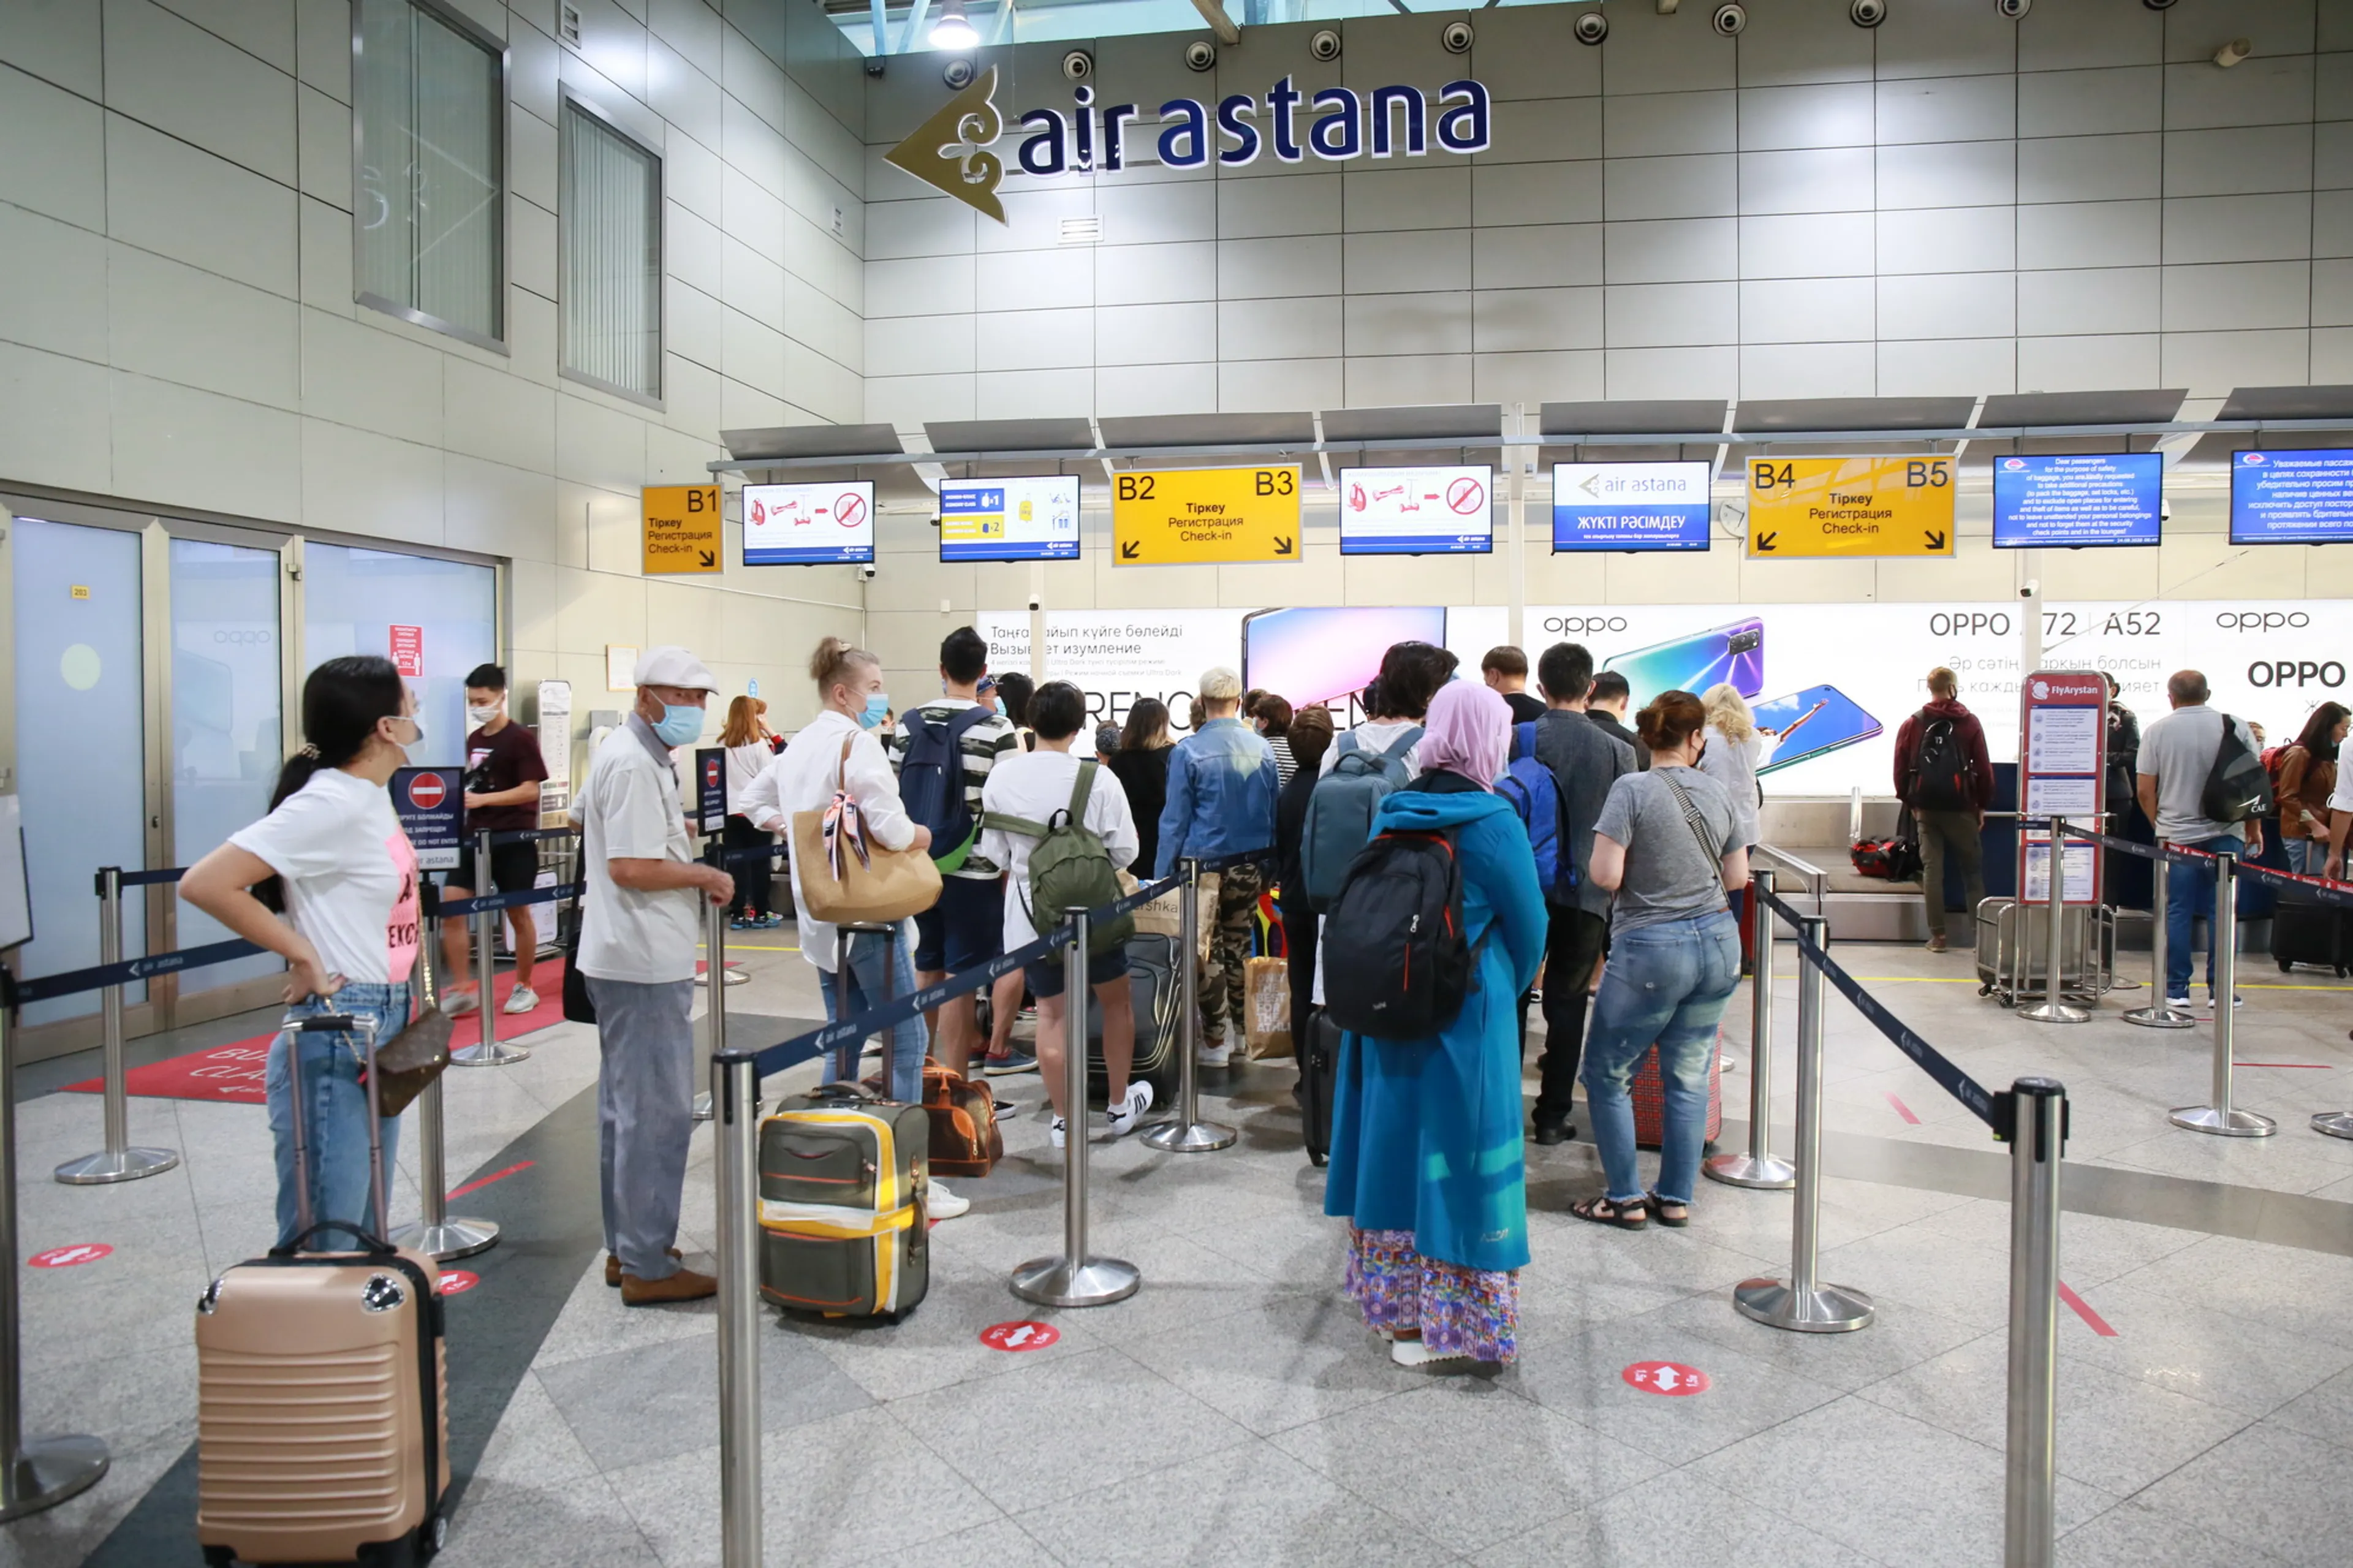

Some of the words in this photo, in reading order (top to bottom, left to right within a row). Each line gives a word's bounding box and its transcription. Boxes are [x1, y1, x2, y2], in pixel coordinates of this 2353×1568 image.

[1018, 85, 1139, 178] air
[1157, 73, 1491, 171] astana
[1755, 463, 1795, 489] B4
[1906, 461, 1948, 487] B5
[1118, 475, 1155, 501] B2
[1256, 471, 1294, 496] B3
[1605, 477, 1626, 491] air
[1631, 478, 1686, 491] astana
[2256, 480, 2310, 490] убедительно
[2312, 480, 2344, 489] просим
[688, 489, 717, 512] B1
[1829, 493, 1873, 506] Тіркеу
[2294, 501, 2323, 510] доступ
[1186, 502, 1226, 515] Тіркеу
[1809, 507, 1892, 521] Регистрация
[648, 517, 683, 529] Тіркеу
[1168, 517, 1244, 529] Регистрация
[1577, 516, 1617, 529] ЖҮКТІ
[1621, 515, 1686, 531] РӘСІМДЕУ
[1822, 522, 1879, 534] Check-in
[648, 530, 713, 542] Регистрация
[1180, 529, 1232, 542] Check-in
[648, 543, 693, 554] Check-in
[1544, 616, 1627, 637] oppo
[1930, 613, 2010, 636] OPPO
[2020, 612, 2077, 635] 72
[2103, 612, 2161, 635] A52
[2216, 612, 2310, 634] oppo
[990, 626, 1078, 639] Таңғаайып
[1083, 626, 1121, 640] күйге
[1126, 624, 1183, 639] бөлейді
[1063, 643, 1142, 657] изумление
[2041, 658, 2092, 673] арқын
[2097, 655, 2161, 670] болсын
[2248, 661, 2346, 688] OPPO
[2052, 685, 2098, 695] FlyArystan
[2251, 803, 2267, 813] CAE
[426, 856, 454, 865] astana
